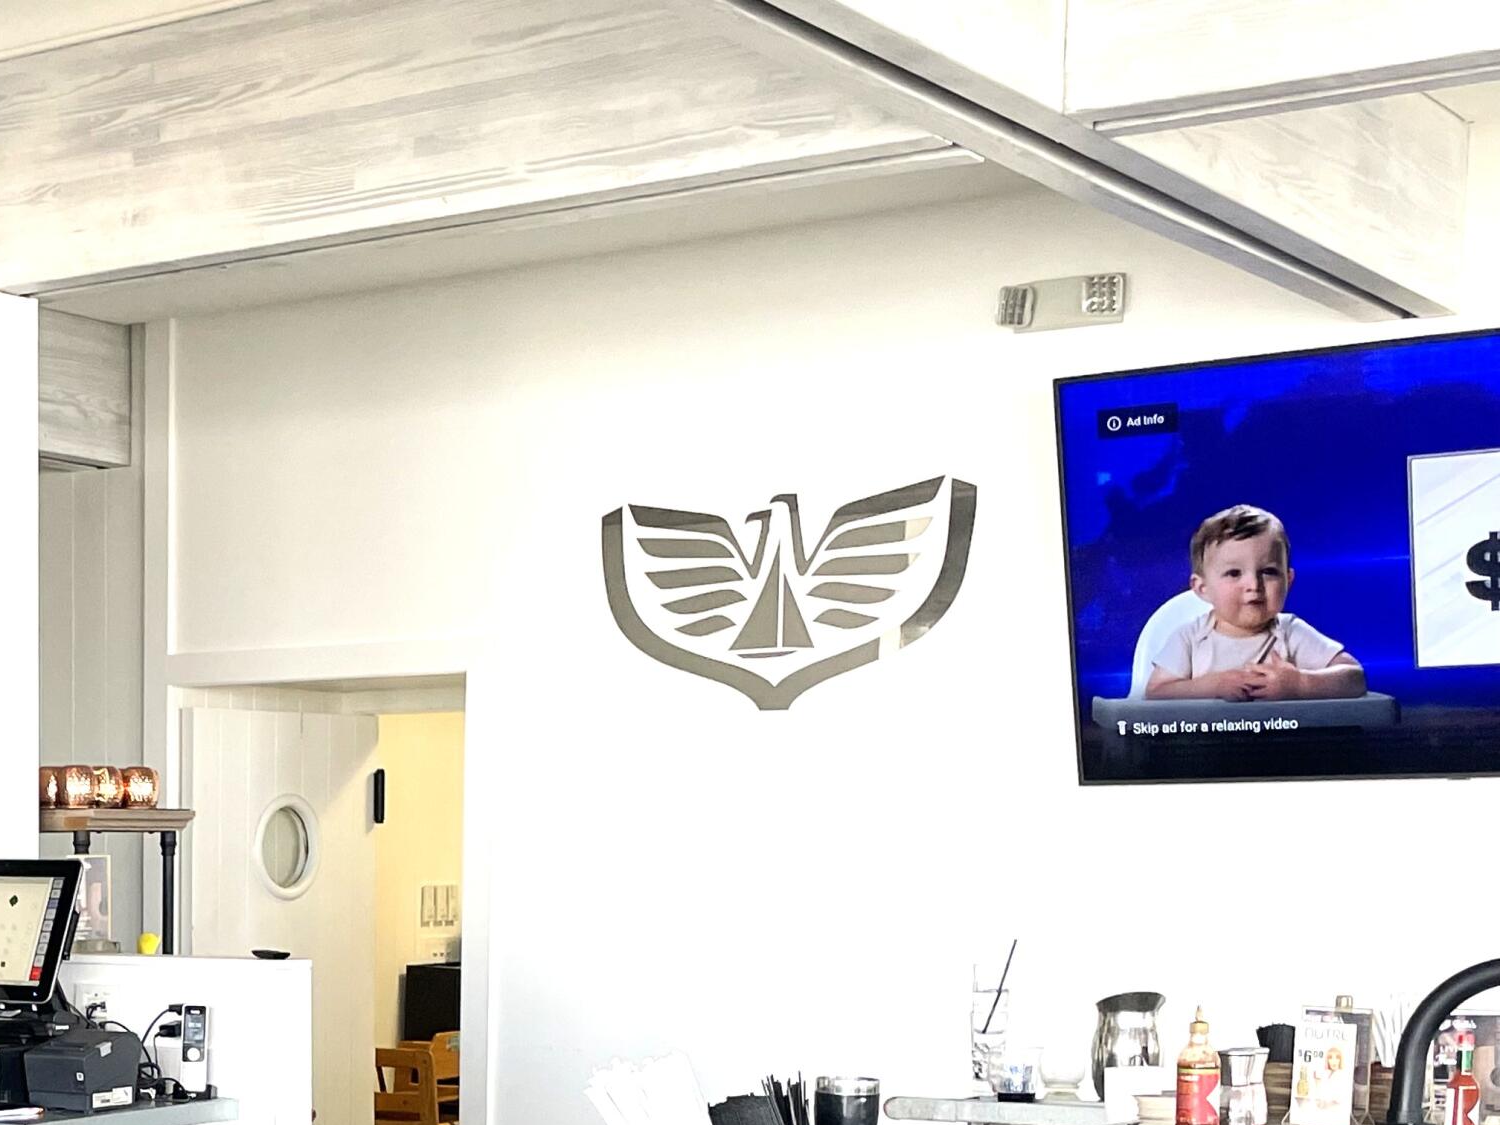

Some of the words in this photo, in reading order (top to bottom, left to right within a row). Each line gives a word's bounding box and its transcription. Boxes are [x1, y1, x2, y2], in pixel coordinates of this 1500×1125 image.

[1126, 416, 1142, 427] Ad
[1143, 413, 1165, 425] Info
[1132, 722, 1159, 736] Skip
[1162, 721, 1177, 734] ad
[1180, 720, 1198, 733] for
[1201, 722, 1209, 732] a
[1211, 718, 1261, 733] relaxing
[1263, 717, 1298, 730] video
